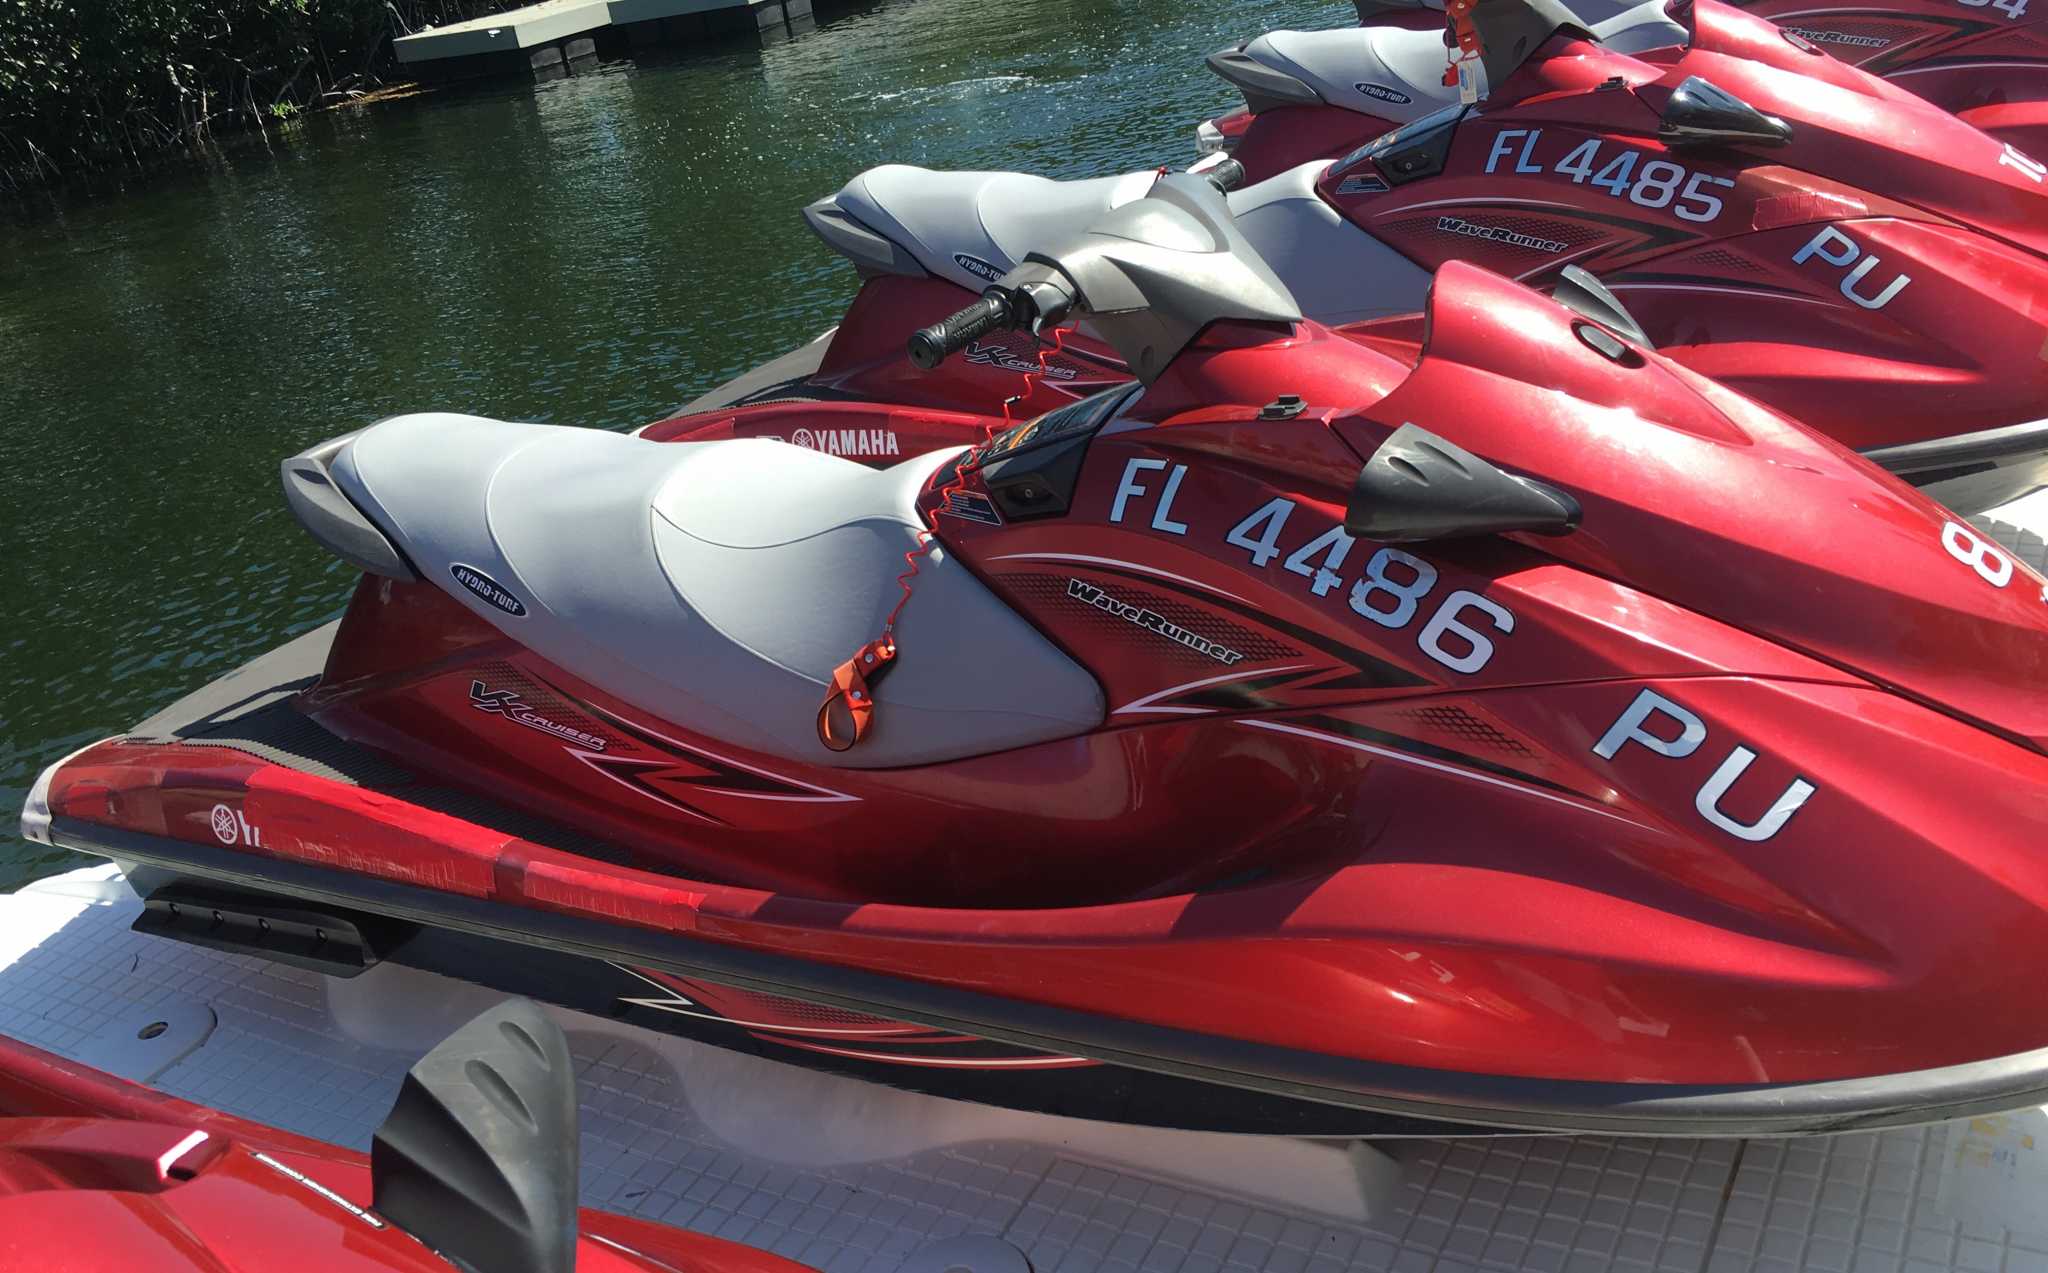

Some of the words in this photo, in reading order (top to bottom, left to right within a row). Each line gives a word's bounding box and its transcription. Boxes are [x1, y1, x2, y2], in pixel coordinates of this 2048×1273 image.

[1360, 84, 1407, 103] HYDRO-TURF
[1485, 128, 1544, 174] FL
[1554, 139, 1736, 223] 4485
[1437, 216, 1568, 253] WaveRunner
[1791, 224, 1912, 310] PU
[963, 341, 1018, 368] VX
[815, 429, 900, 456] YAMAHA
[457, 568, 519, 612] HYDRO-TURF
[1109, 457, 1188, 536] FL
[1225, 496, 1516, 675] 4486
[1067, 578, 1243, 665] WaveRunner
[469, 680, 534, 721] VX
[521, 712, 607, 747] CRUISER
[1593, 688, 1819, 843] PU
